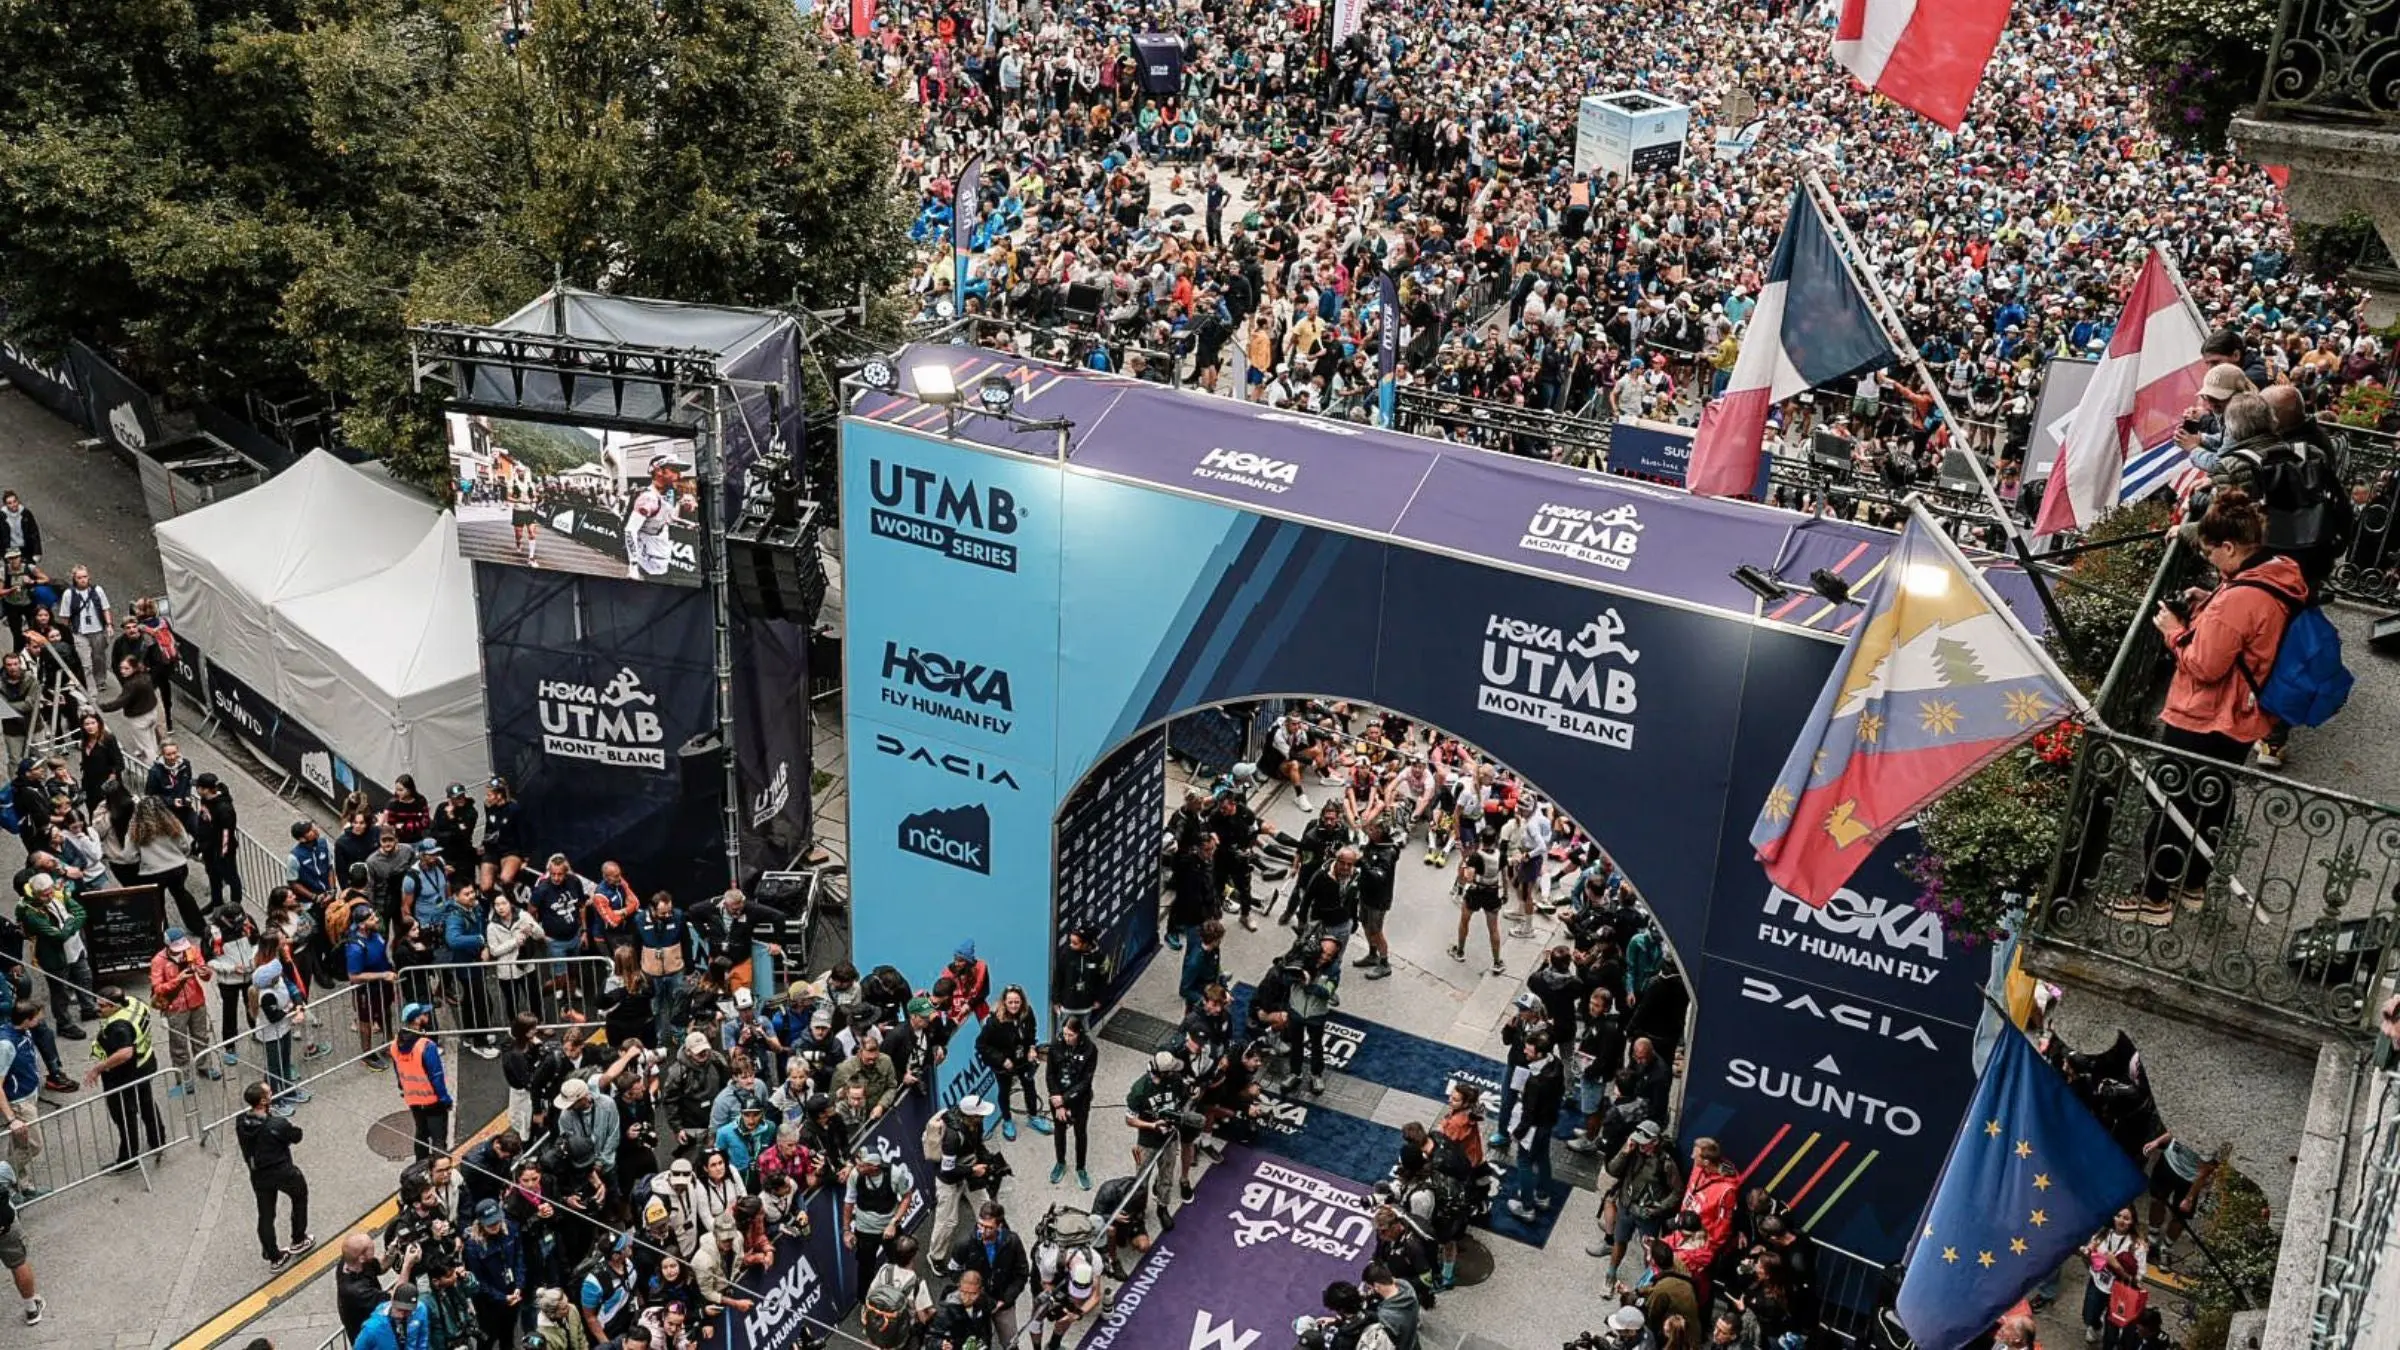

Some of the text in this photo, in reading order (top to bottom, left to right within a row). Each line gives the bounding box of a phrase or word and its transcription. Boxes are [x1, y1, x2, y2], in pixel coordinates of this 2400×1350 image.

[1193, 467, 1288, 494] FLY HUMAN FLY
[1200, 448, 1299, 484] HOKA
[1529, 515, 1638, 554] UTMB
[1537, 503, 1593, 521] HOKA
[876, 514, 1012, 566] WORLD SERIES
[1486, 614, 1563, 652] HOKA
[539, 679, 598, 705] HOKA
[882, 641, 1013, 712] HOKA
[1482, 640, 1637, 714] UTMB
[539, 700, 663, 744] UTMB
[881, 687, 1012, 735] FLY HUMAN FLY
[755, 761, 787, 812] UTMB
[876, 734, 1020, 791] DACIA
[908, 827, 981, 866] näak
[1758, 922, 1940, 985] FLY HUMAN FLY
[1741, 976, 1939, 1052] DACIA
[1726, 1058, 1921, 1136] SUUNTO
[1260, 1165, 1362, 1209] ONT-BLANC
[1240, 1182, 1373, 1247] UTMB
[1291, 1227, 1360, 1261] HOKA
[744, 1254, 819, 1350] HOKA
